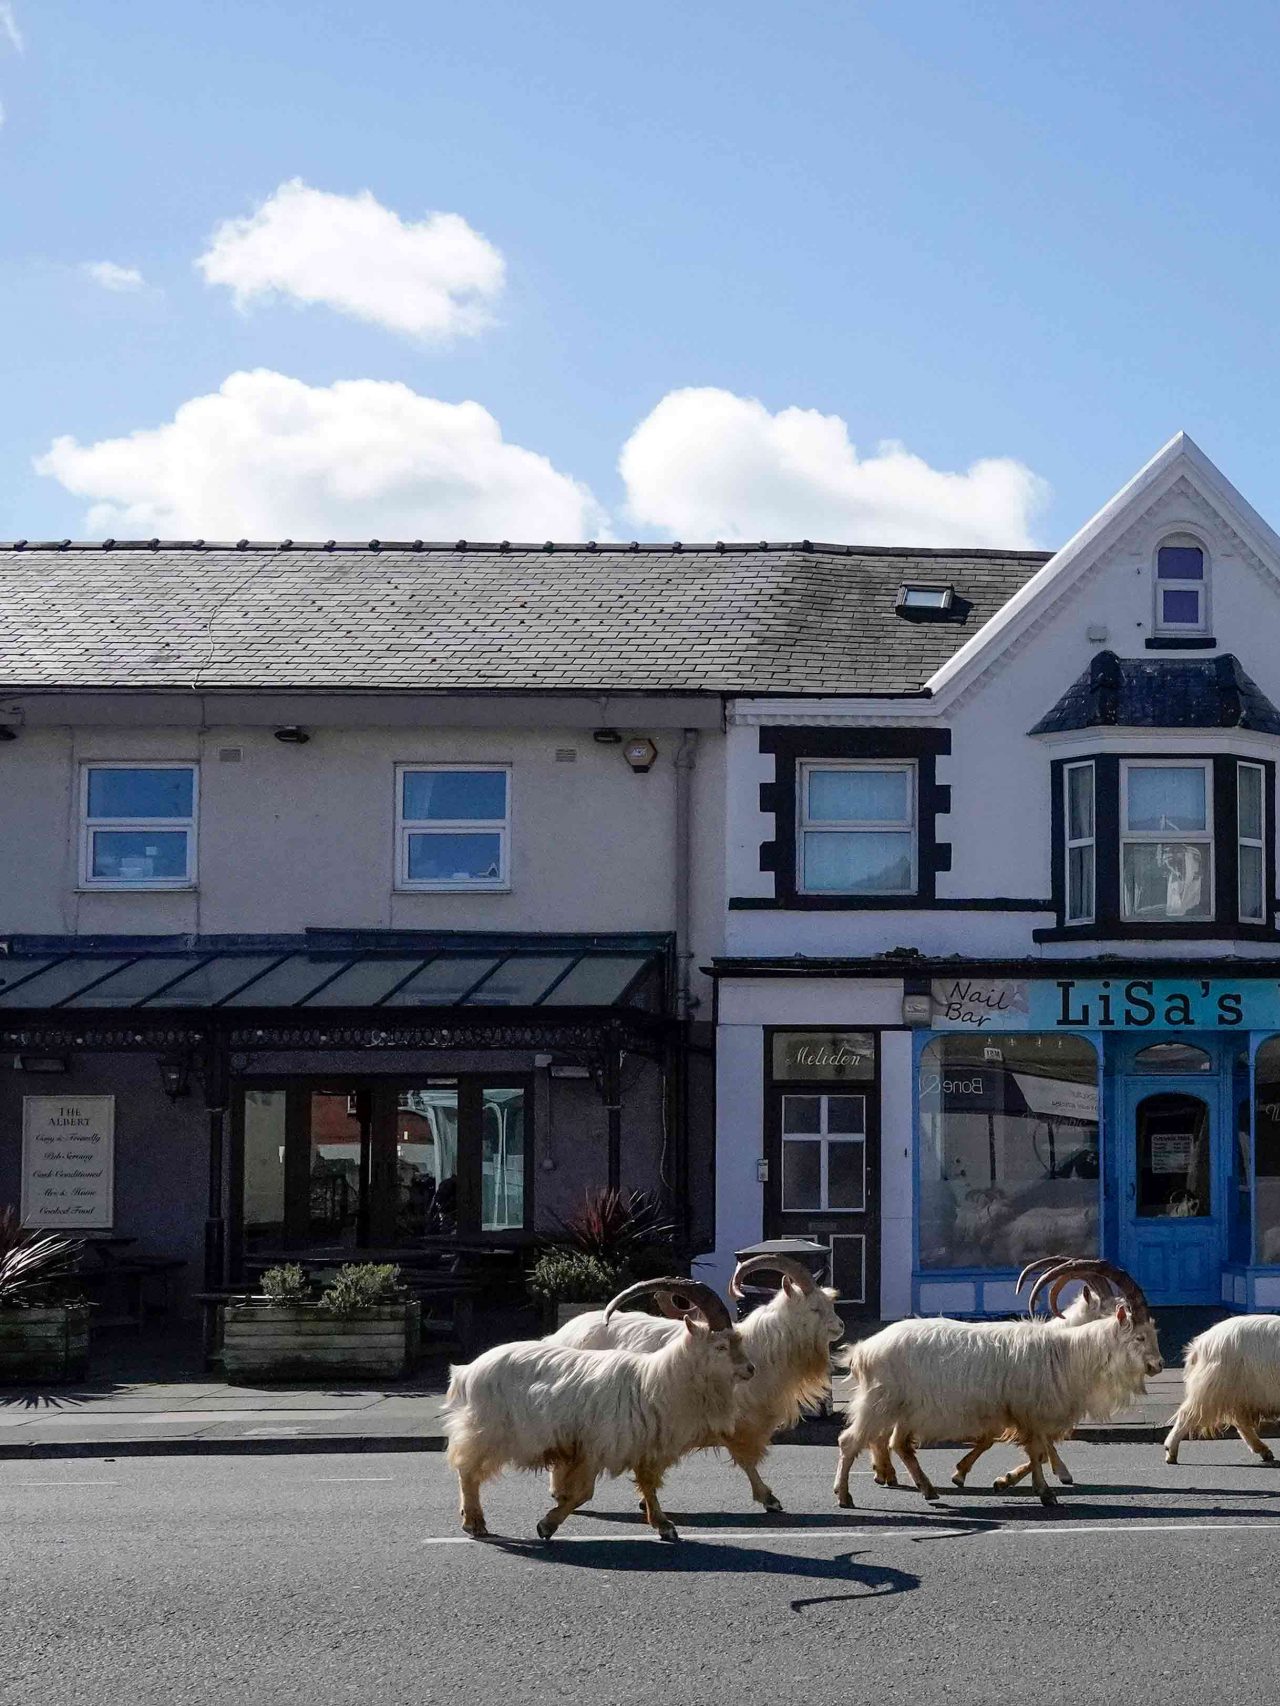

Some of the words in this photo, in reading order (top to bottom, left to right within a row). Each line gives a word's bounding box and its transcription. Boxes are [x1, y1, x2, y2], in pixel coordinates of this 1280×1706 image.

[950, 982, 1009, 1010] Nail
[1056, 980, 1243, 1025] LiSa's
[945, 1003, 991, 1027] Bar
[796, 1046, 861, 1066] Meliden
[49, 1118, 90, 1127] ALBERT
[58, 1107, 81, 1117] THE
